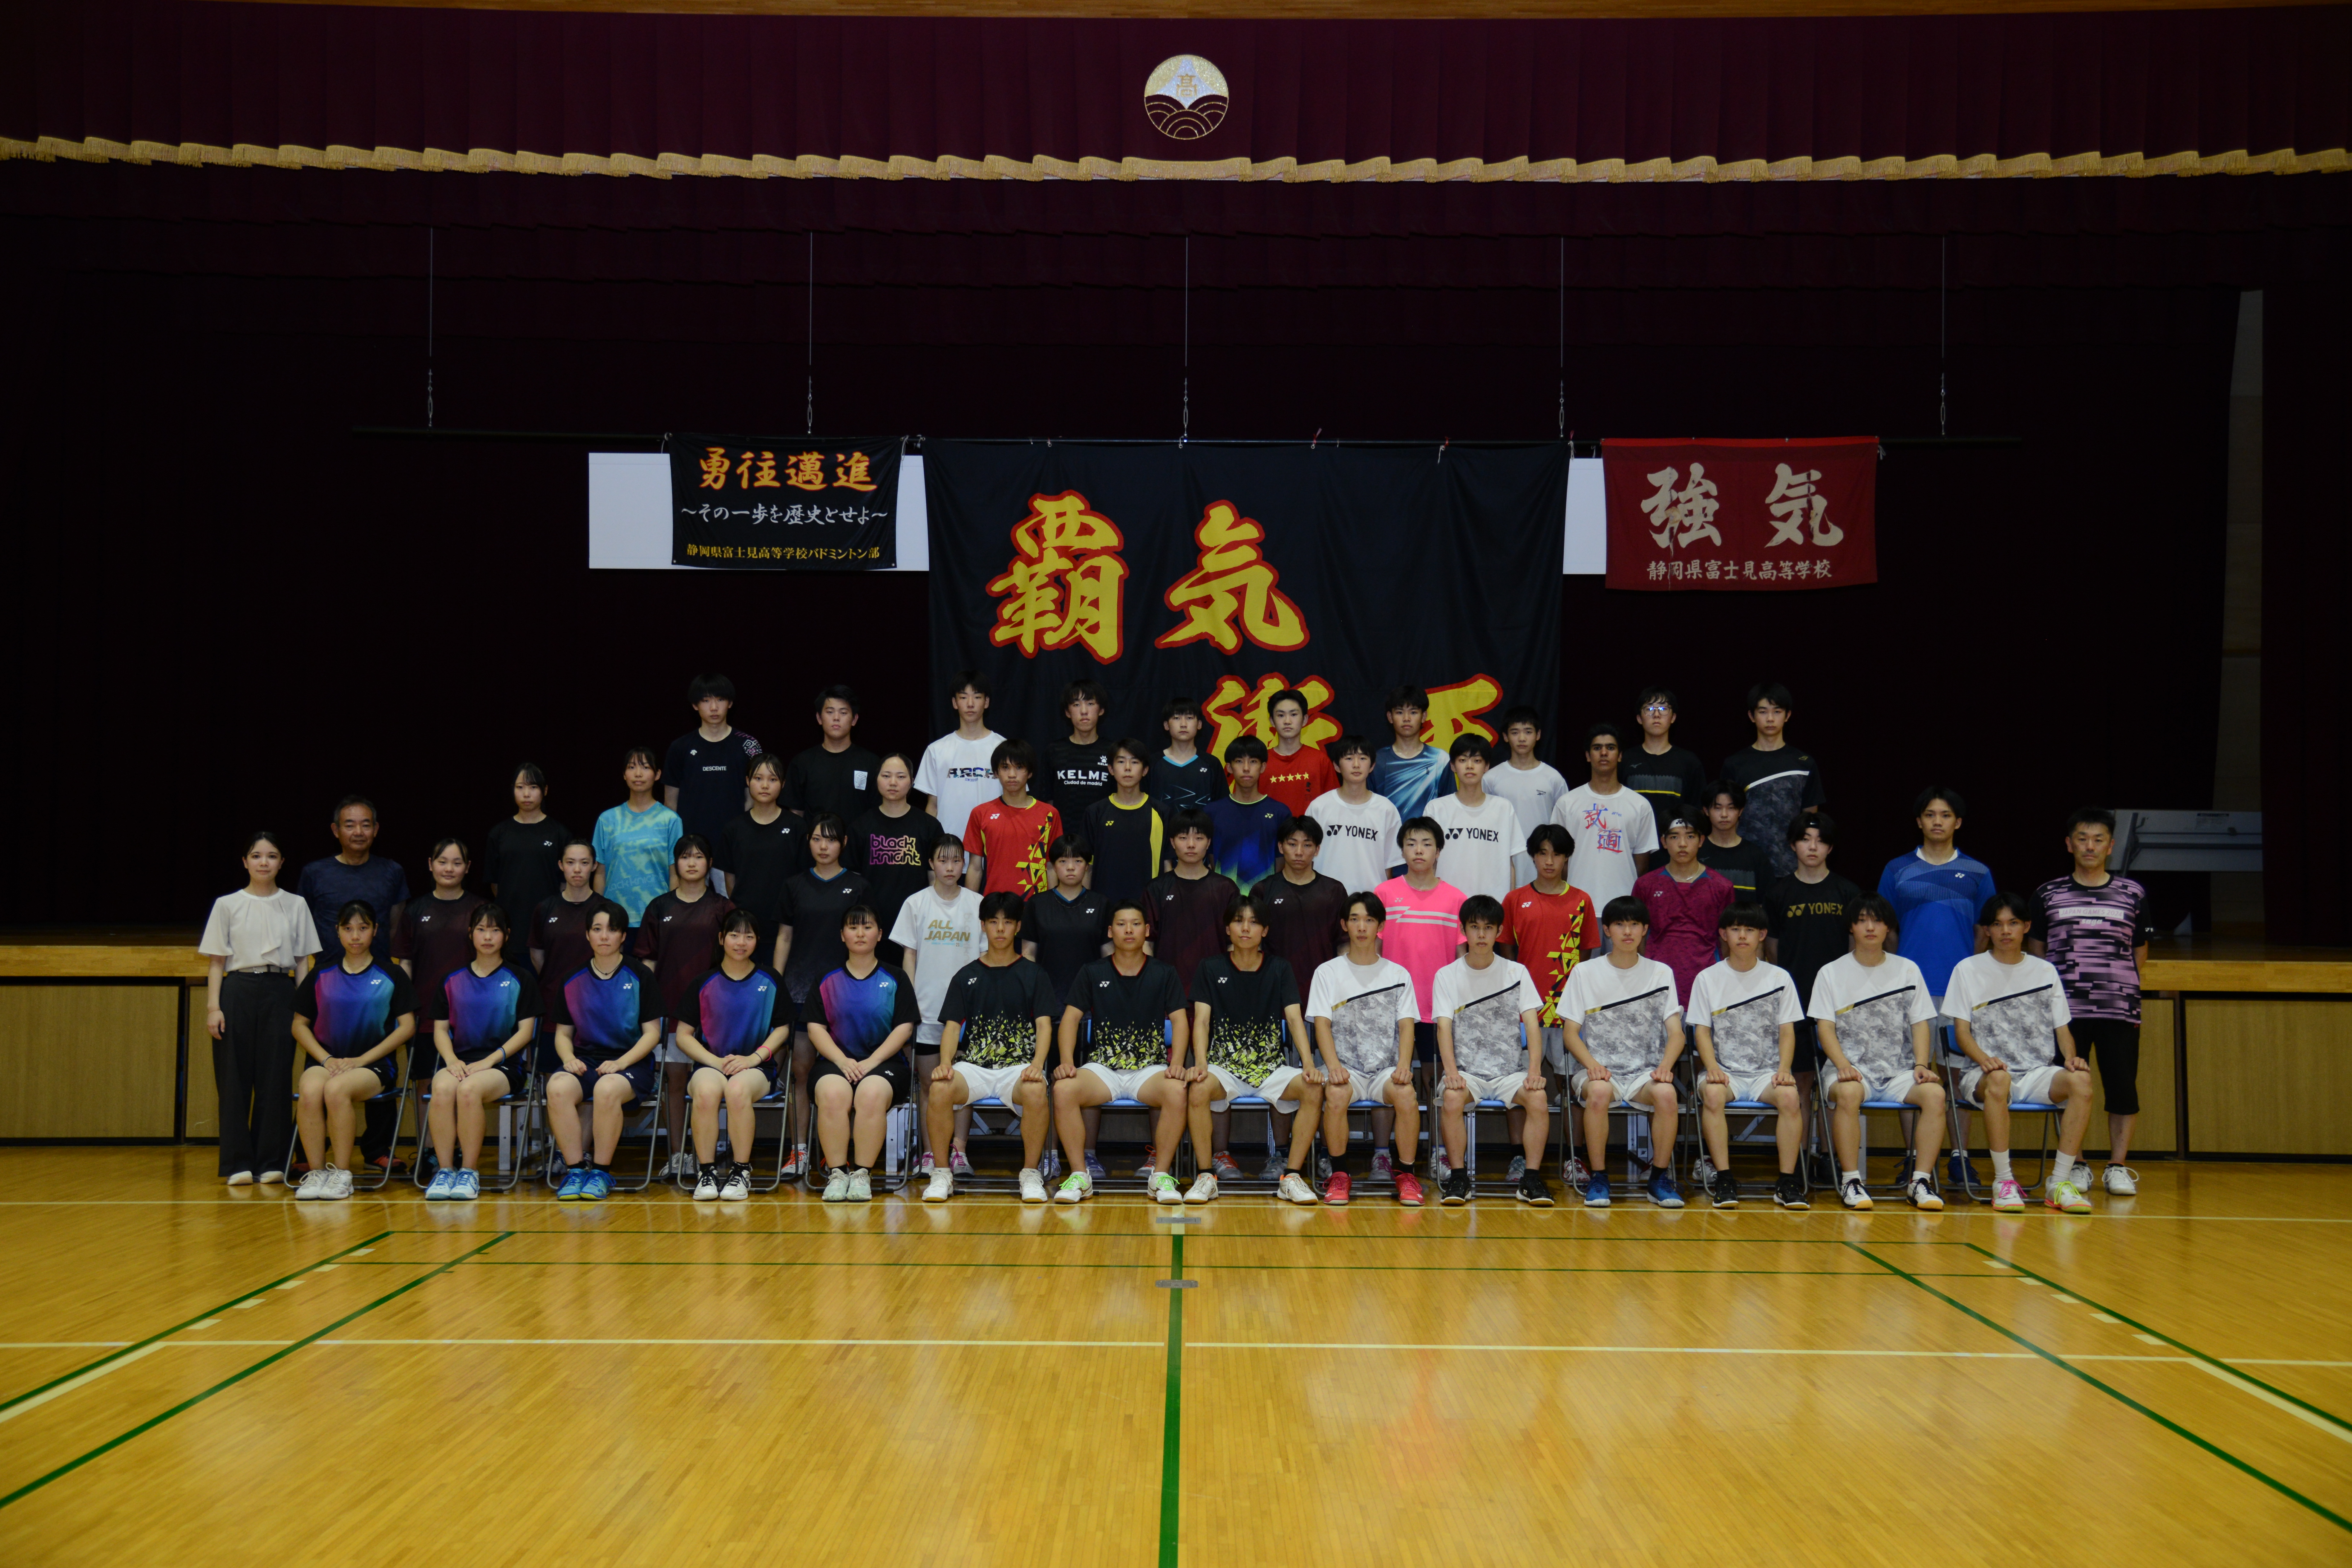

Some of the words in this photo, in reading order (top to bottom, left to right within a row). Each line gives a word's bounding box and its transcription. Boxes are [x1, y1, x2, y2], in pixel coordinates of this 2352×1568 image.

[699, 447, 878, 492] 勇往邁進
[1640, 462, 1844, 549] 強気
[686, 544, 880, 559] 静岡県富士見高等学校バドミントン部
[986, 489, 1310, 665] 覇気
[1646, 559, 1833, 581] 静岡県富士見高等学校
[1057, 770, 1109, 781] KELME
[1345, 825, 1378, 842] YONEX
[1466, 828, 1499, 842] YONEX
[870, 834, 916, 850] black
[870, 848, 921, 866] knight
[1808, 902, 1844, 916] YONEX
[928, 919, 954, 930] ALL
[924, 931, 971, 942] JAPAN
